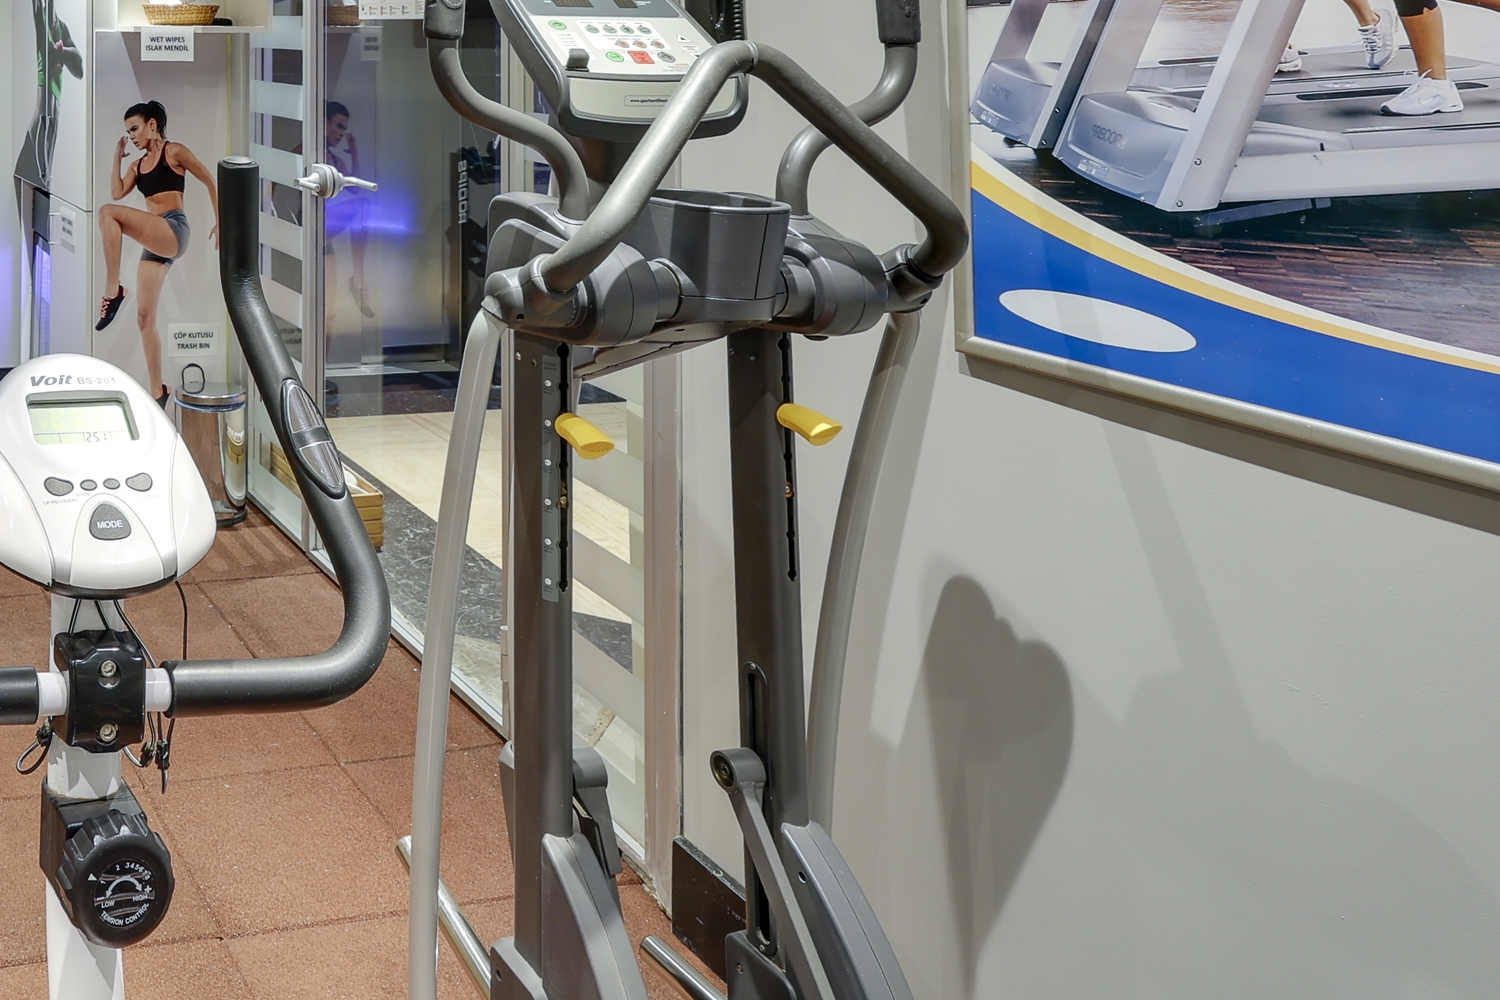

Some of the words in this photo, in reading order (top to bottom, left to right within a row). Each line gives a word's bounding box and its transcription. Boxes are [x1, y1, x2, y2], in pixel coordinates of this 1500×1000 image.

[30, 375, 74, 386] Voit
[77, 377, 116, 385] BS-201
[96, 520, 123, 529] MODE
[132, 894, 148, 902] HIGH
[101, 900, 115, 908] LOW
[101, 911, 123, 925] TENSION
[125, 902, 150, 924] CONTROL
